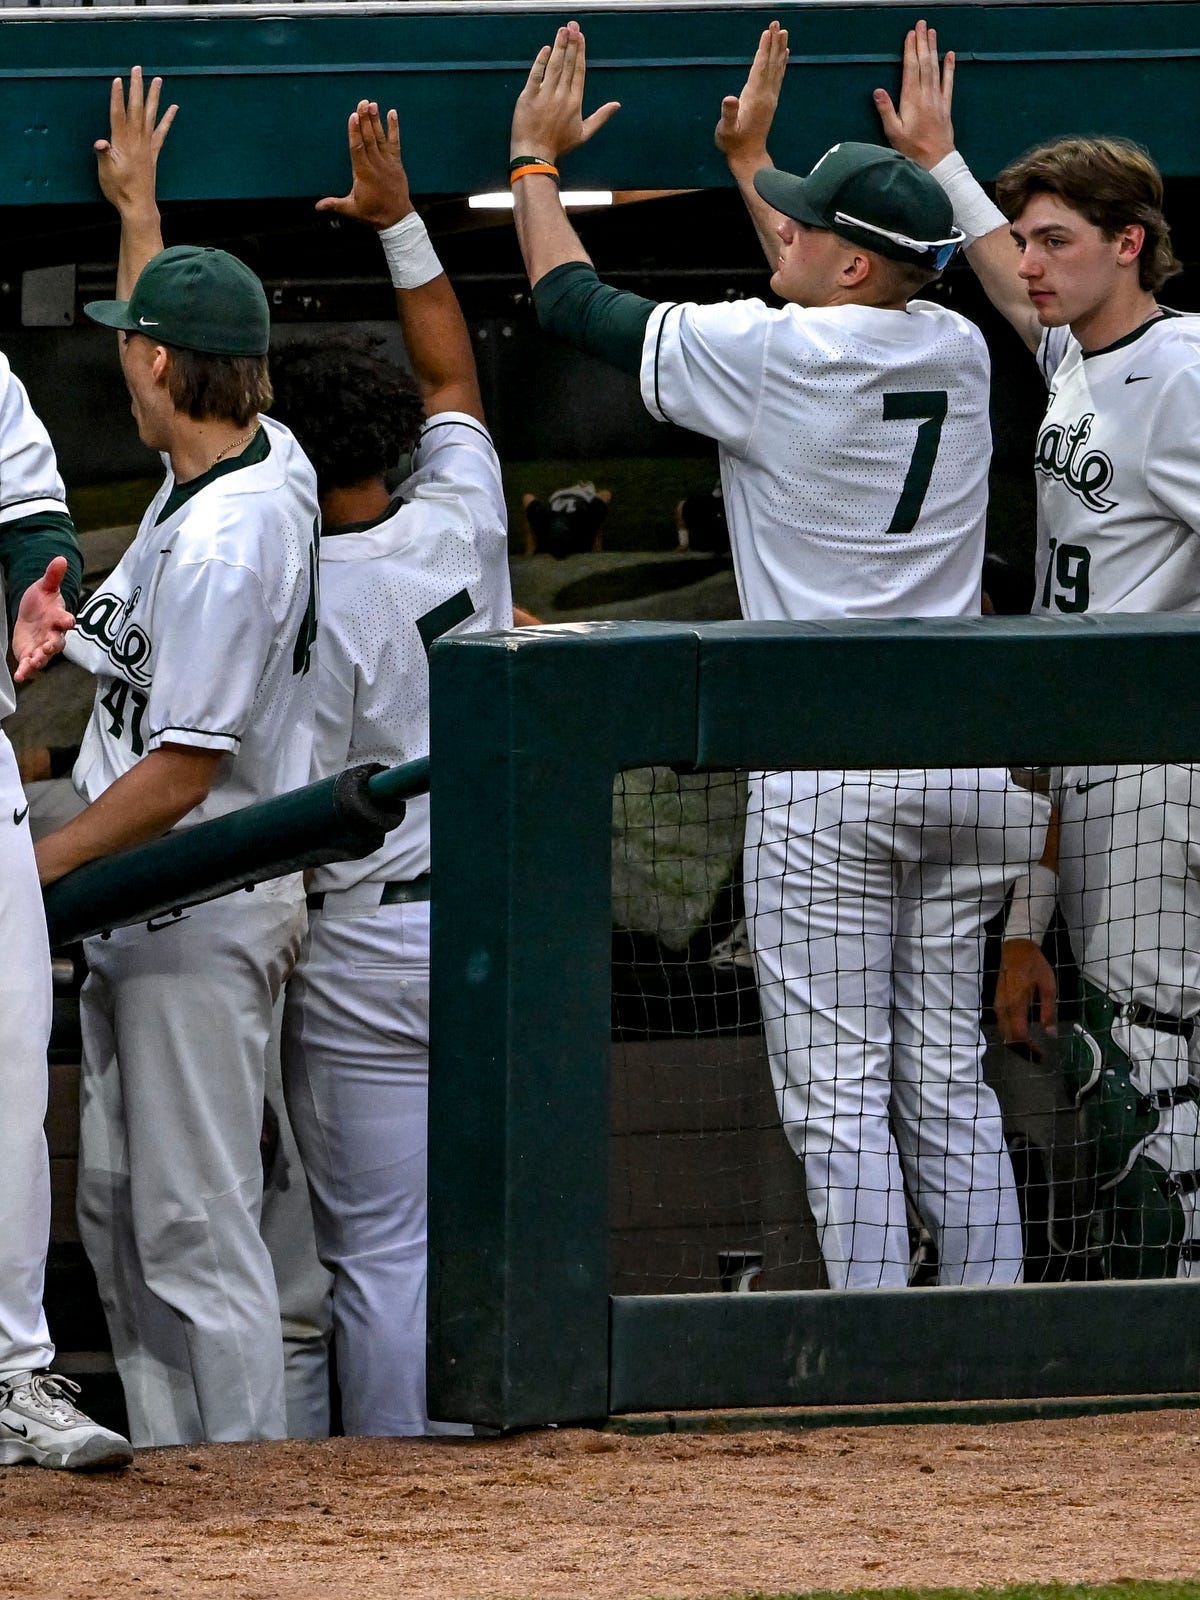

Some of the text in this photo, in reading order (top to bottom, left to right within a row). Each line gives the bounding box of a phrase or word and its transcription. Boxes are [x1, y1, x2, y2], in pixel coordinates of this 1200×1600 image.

[883, 391, 947, 533] 7
[1034, 392, 1119, 513] ate
[76, 586, 152, 687] ate
